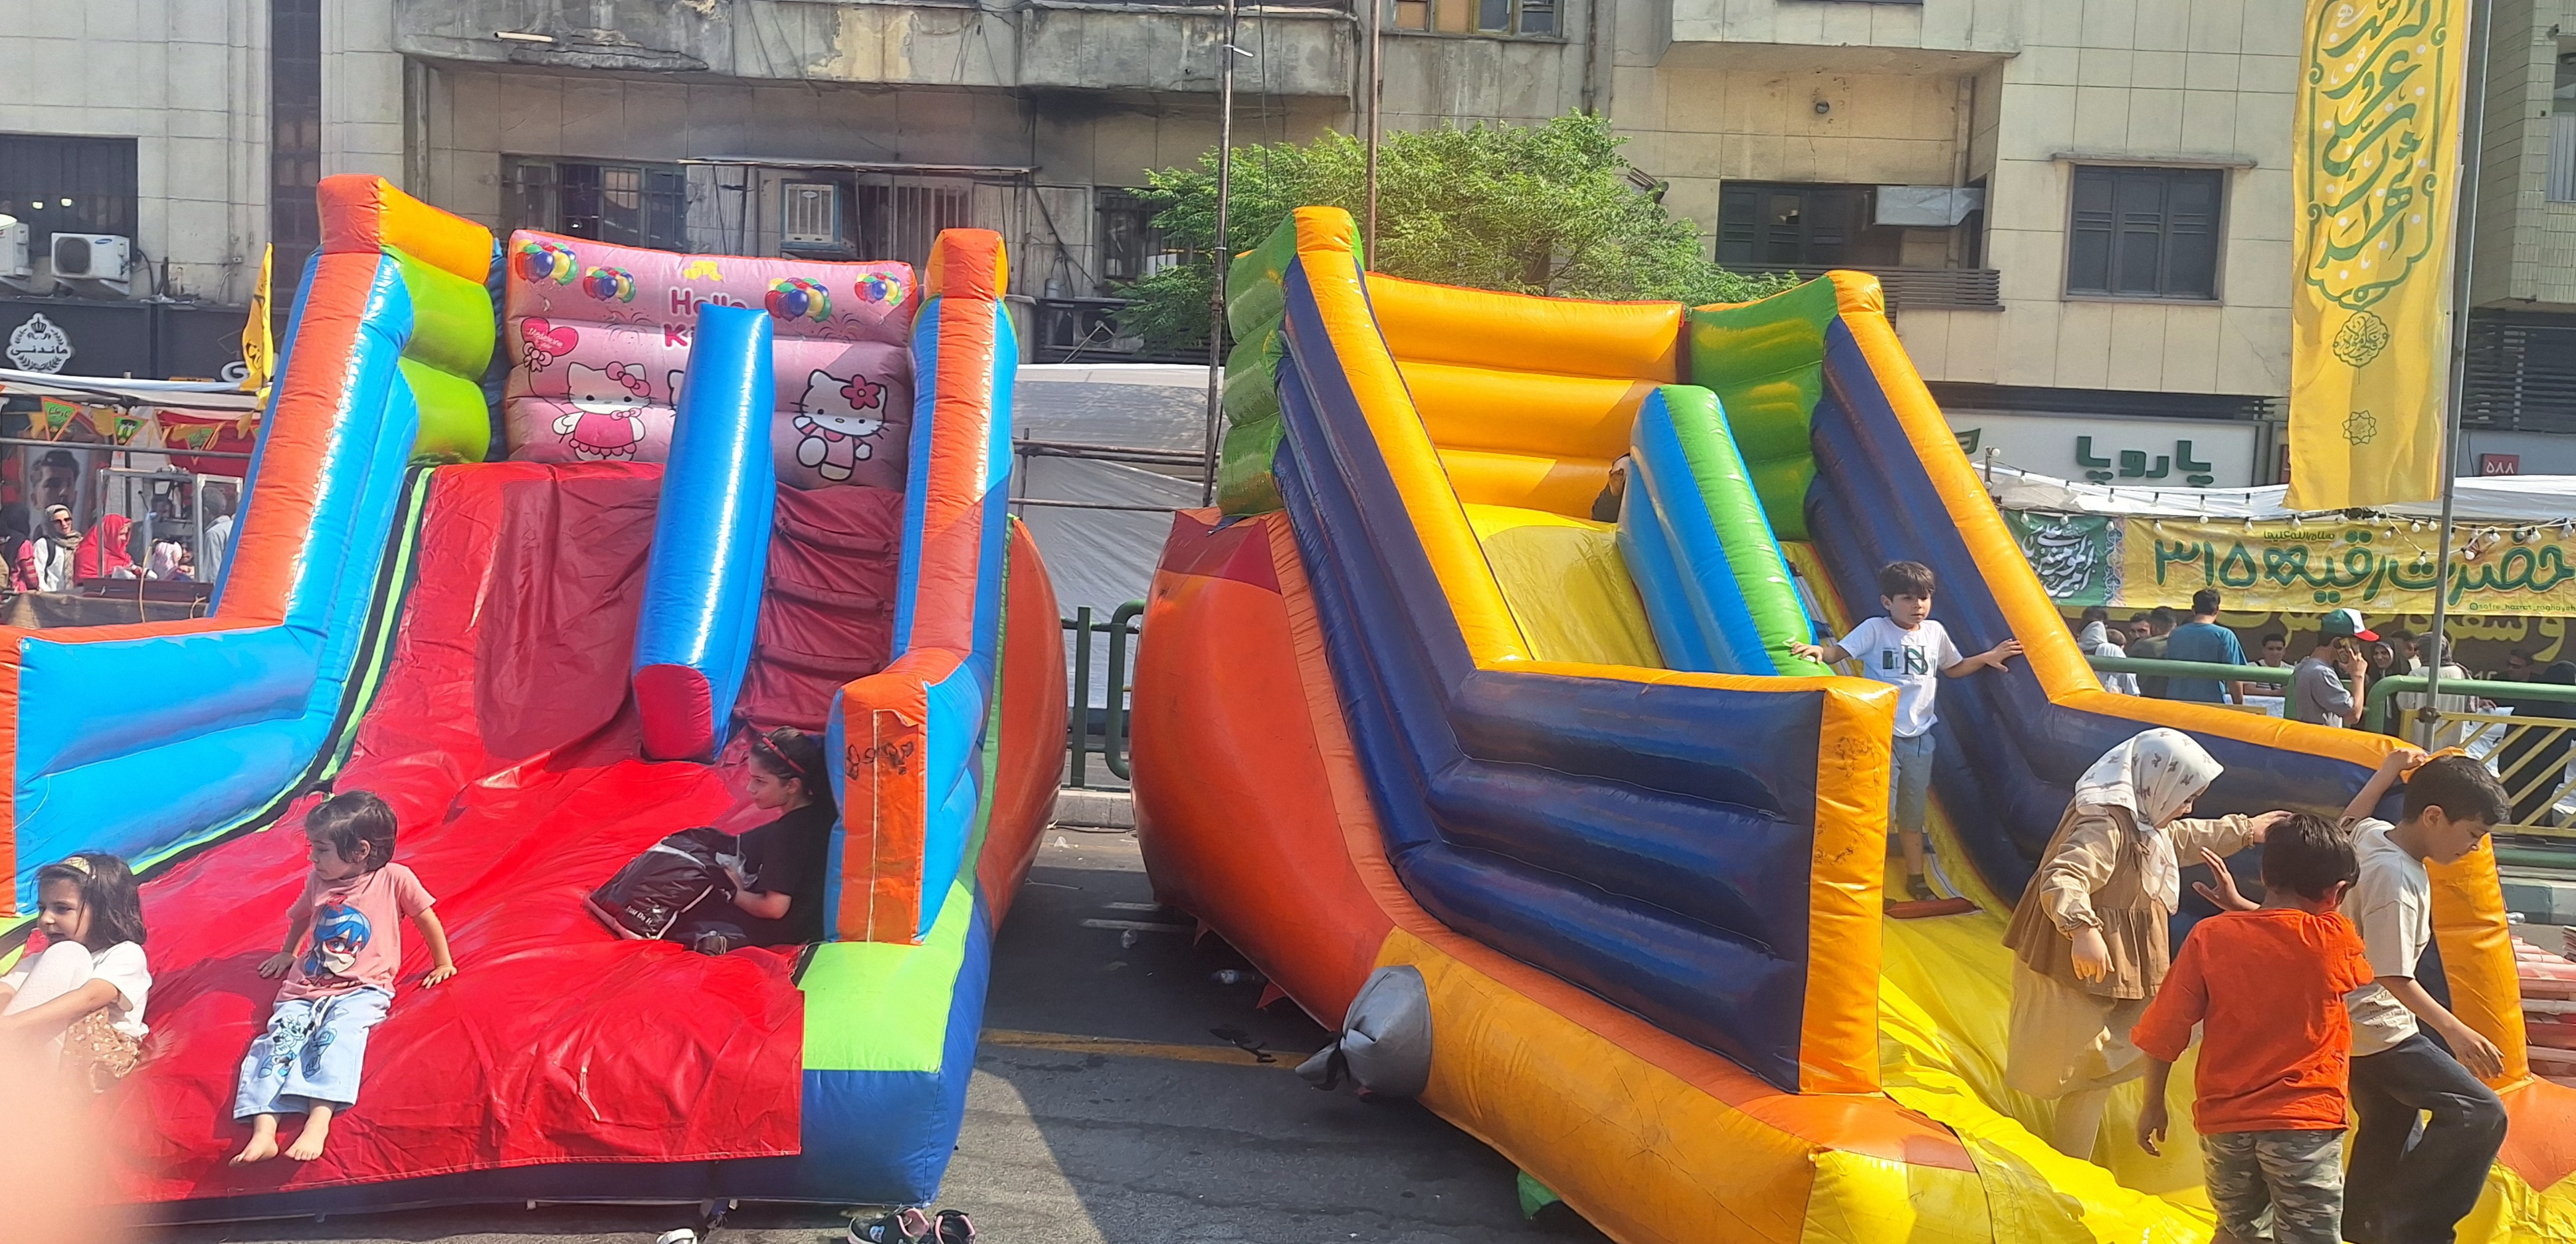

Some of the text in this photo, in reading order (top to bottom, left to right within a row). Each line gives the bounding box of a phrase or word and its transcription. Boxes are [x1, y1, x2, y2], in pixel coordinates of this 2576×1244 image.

[671, 289, 747, 316] Hll
[2486, 461, 2514, 474] ۵۸۸
[2154, 530, 2575, 607] حضرت رقیه ۳۱۵
